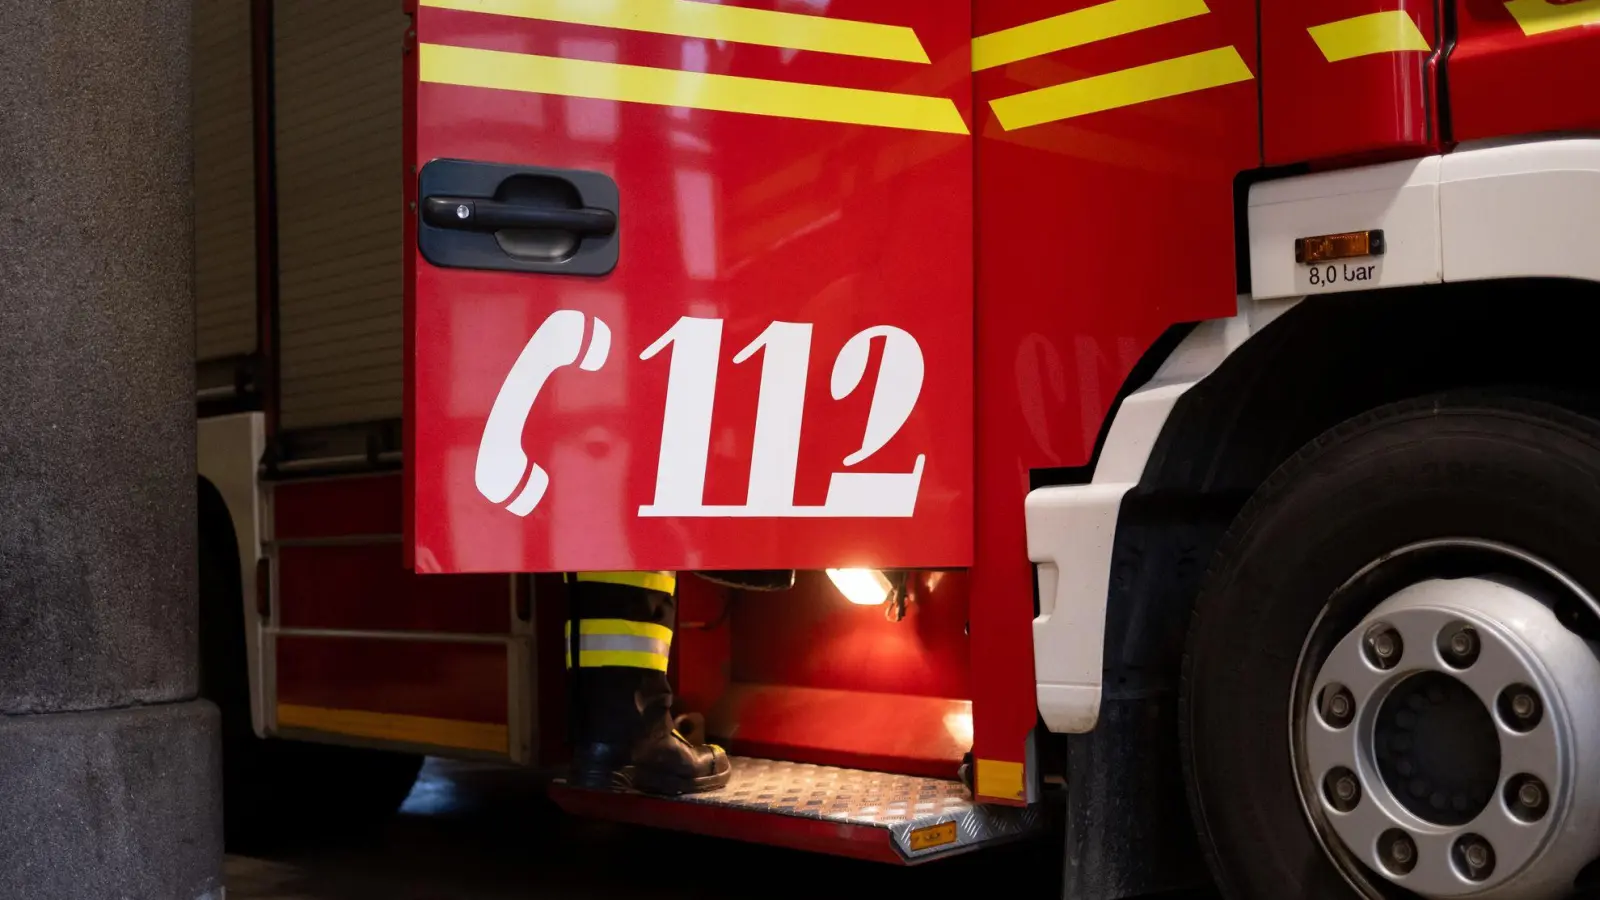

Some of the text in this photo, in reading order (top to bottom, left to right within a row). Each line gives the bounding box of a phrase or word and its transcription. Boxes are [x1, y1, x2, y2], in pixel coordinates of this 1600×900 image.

[1309, 264, 1376, 286] 8,0 bar
[638, 316, 926, 517] 112
